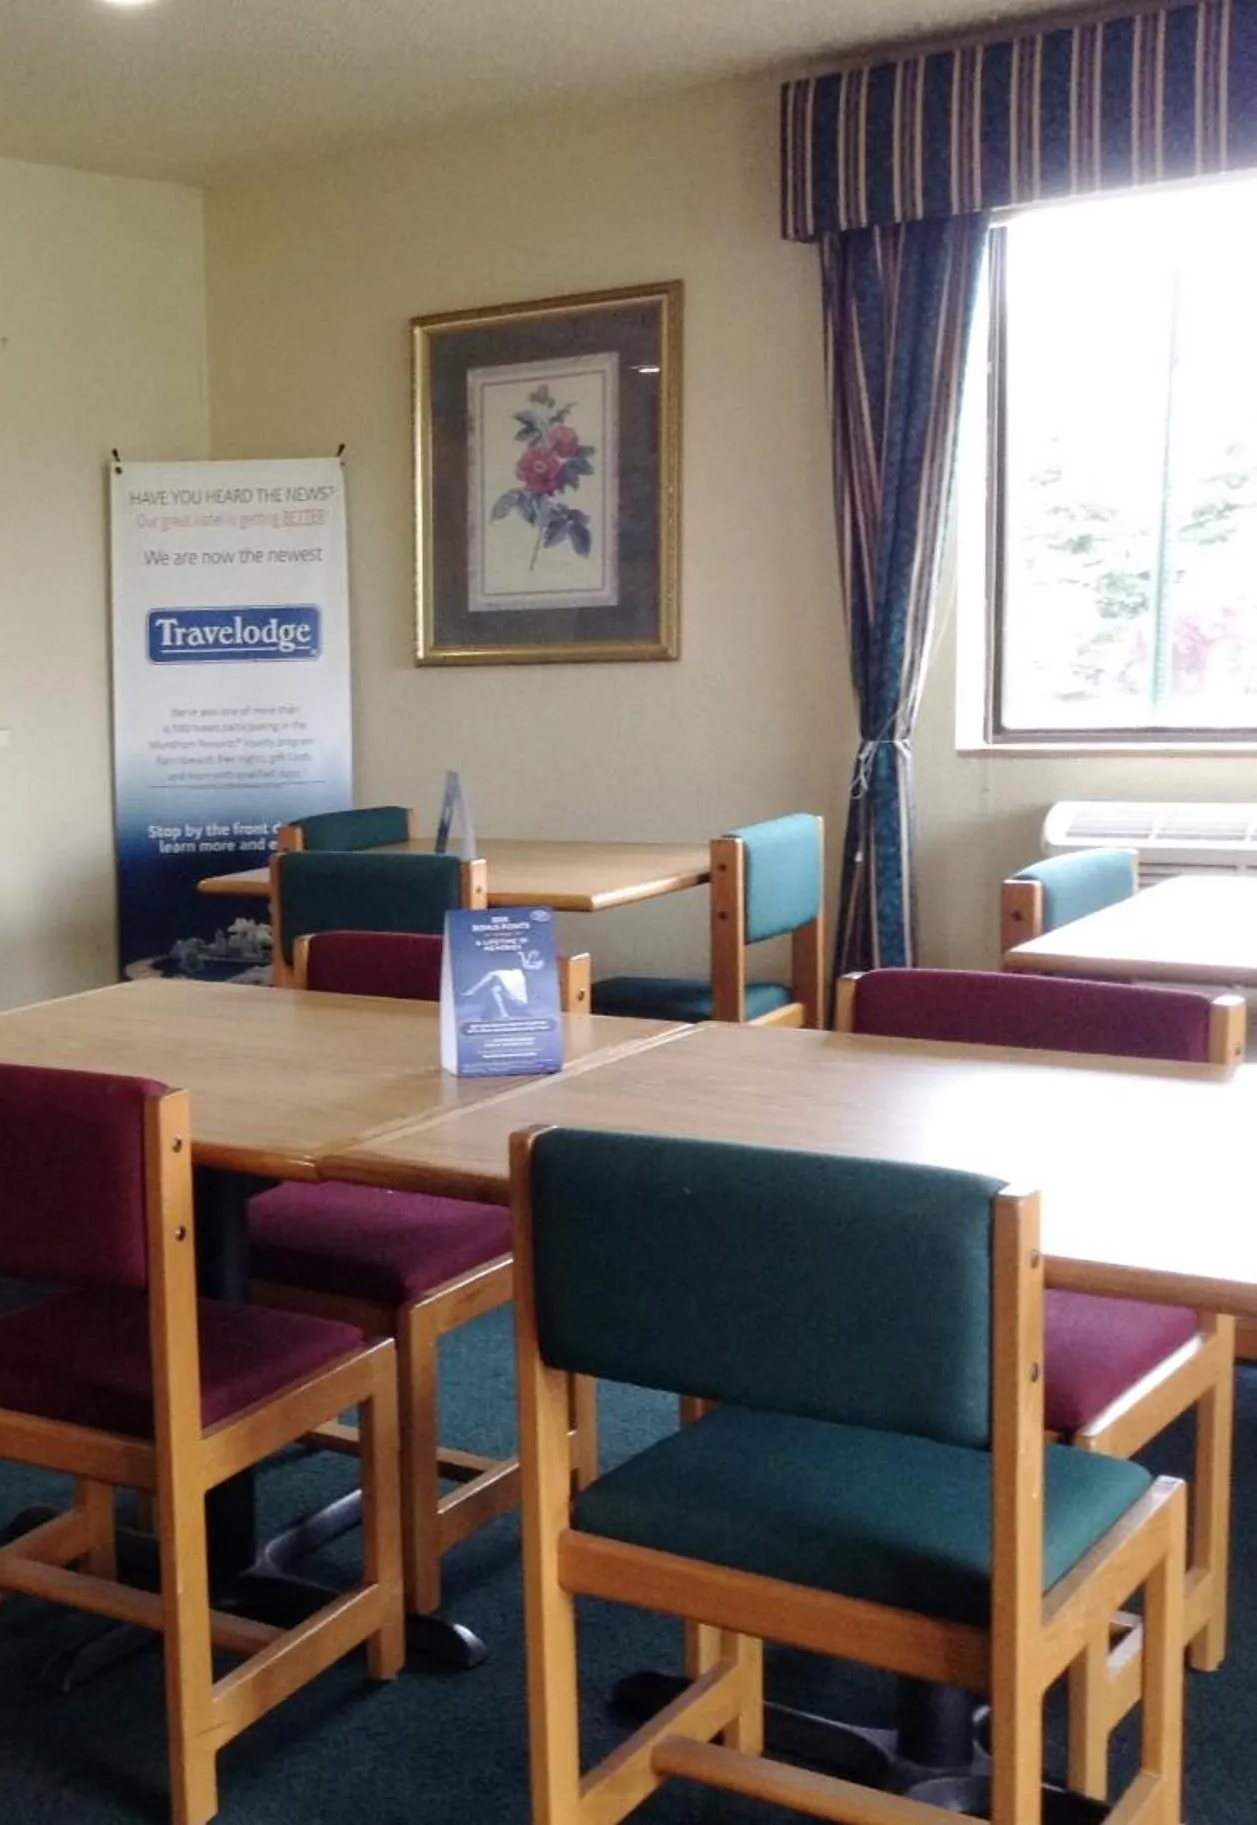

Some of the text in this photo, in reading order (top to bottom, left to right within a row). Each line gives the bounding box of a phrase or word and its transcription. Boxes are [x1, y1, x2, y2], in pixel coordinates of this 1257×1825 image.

[129, 485, 335, 506] HAVE YOU HEARD THE NEWS?
[143, 548, 323, 566] We are now the newest
[154, 615, 312, 652] Travelodge
[148, 824, 181, 840] Stop
[184, 823, 203, 840] by
[205, 823, 230, 836] the
[233, 821, 268, 835] front
[159, 839, 196, 854] learn
[199, 841, 236, 852] more
[239, 838, 266, 851] and
